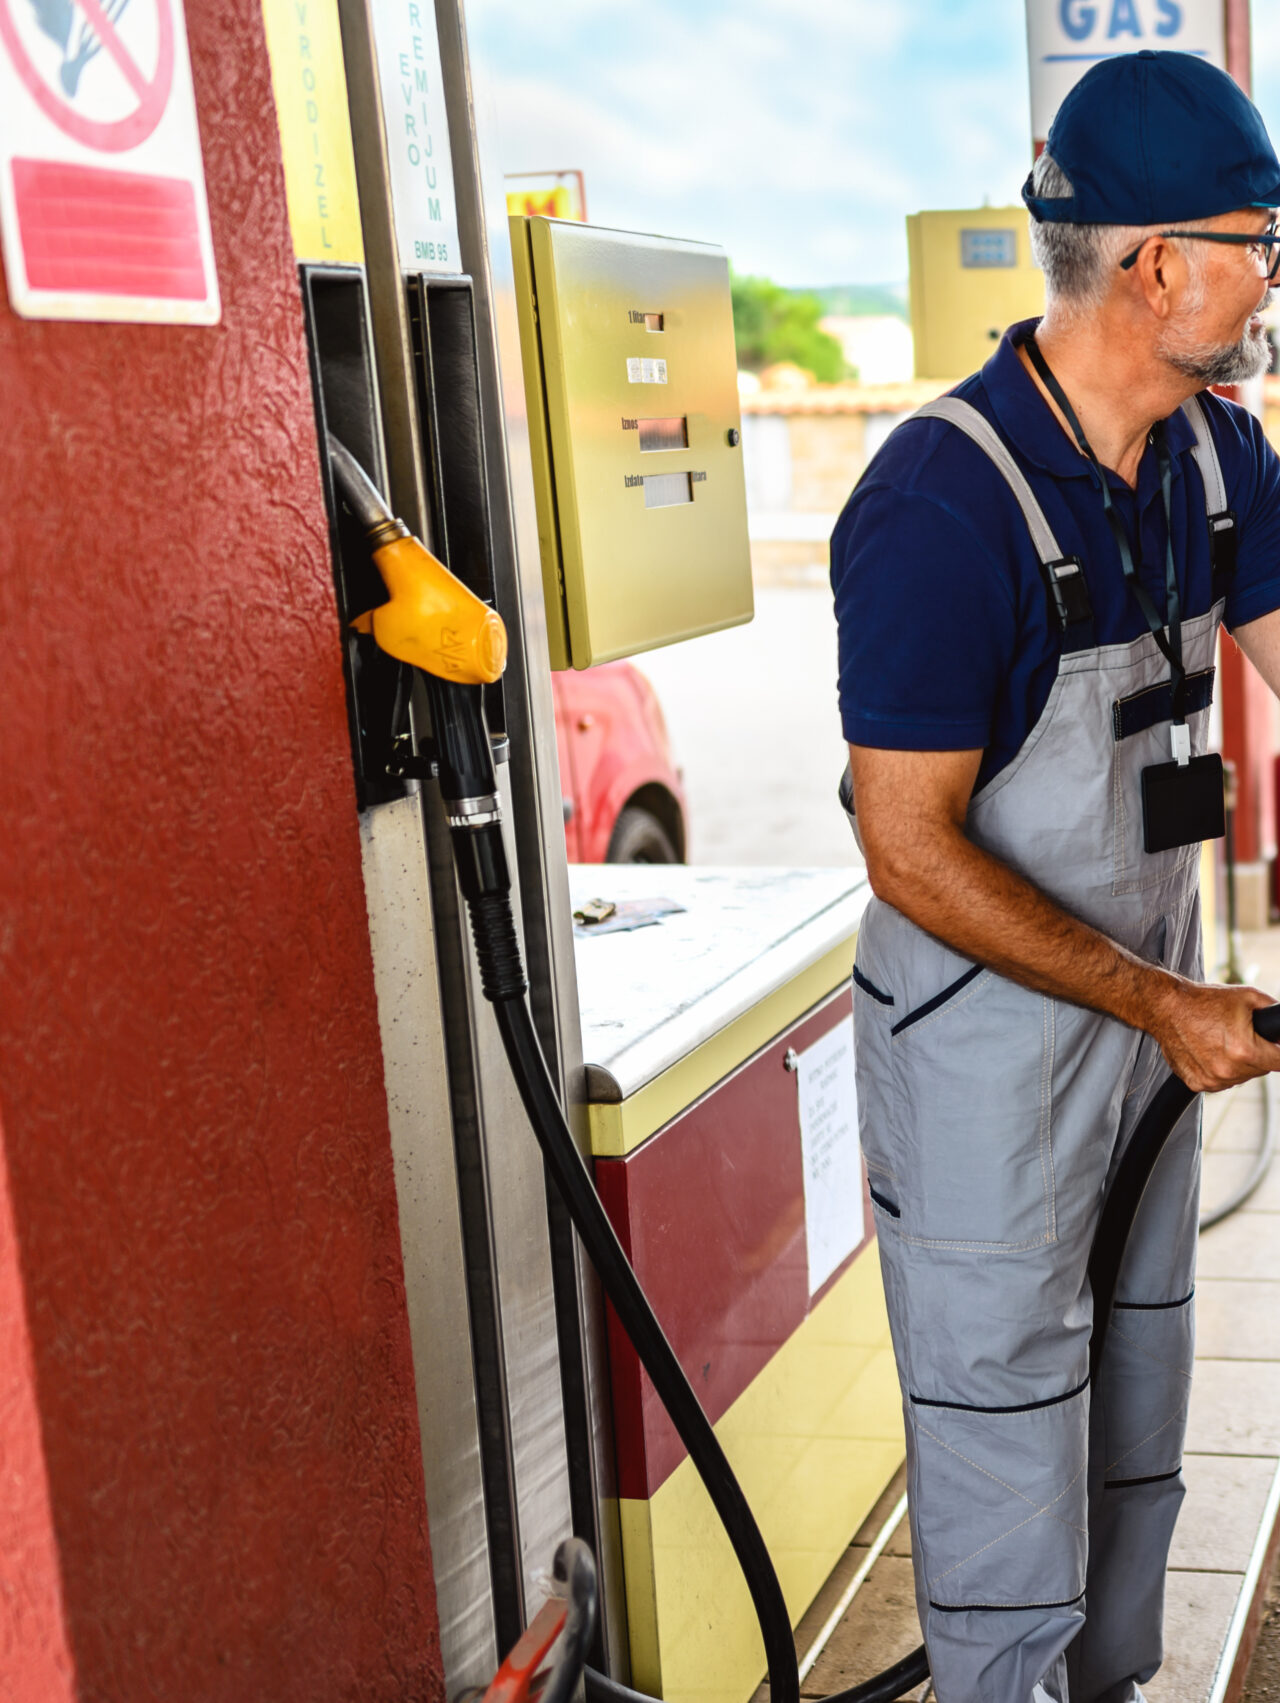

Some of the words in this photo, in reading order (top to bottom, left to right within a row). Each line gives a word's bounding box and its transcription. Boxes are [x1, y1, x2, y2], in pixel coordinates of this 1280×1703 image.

[1060, 0, 1182, 41] GAS
[399, 53, 420, 167] EVRO
[414, 240, 436, 261] BMB
[437, 244, 448, 262] 95
[621, 417, 638, 430] Iznos
